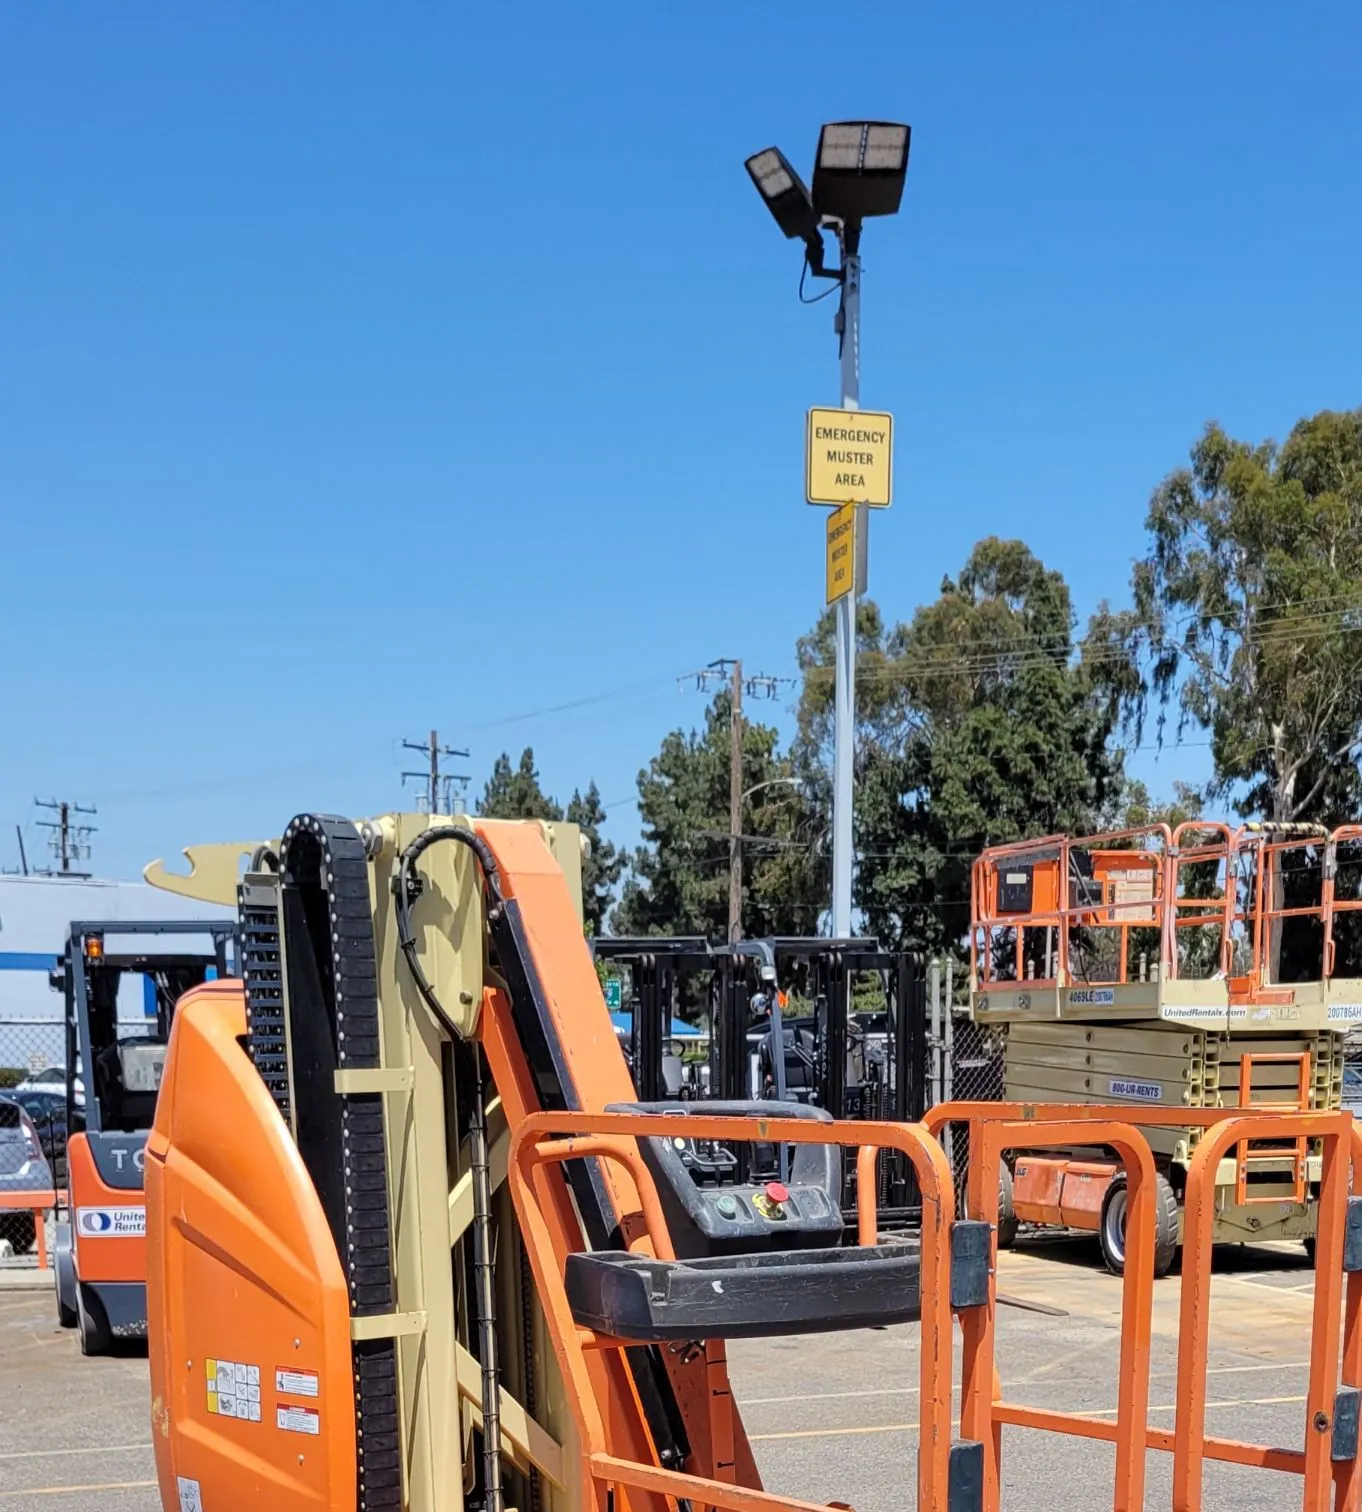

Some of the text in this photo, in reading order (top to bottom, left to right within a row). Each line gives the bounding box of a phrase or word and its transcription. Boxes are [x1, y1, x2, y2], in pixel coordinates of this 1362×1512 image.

[815, 427, 886, 444] EMERGENCY
[826, 450, 874, 465] MUSTER
[834, 473, 866, 487] AREA
[1164, 1008, 1246, 1017] UnitedRentals.com
[110, 1148, 145, 1170] TO
[114, 1212, 145, 1221] Unite
